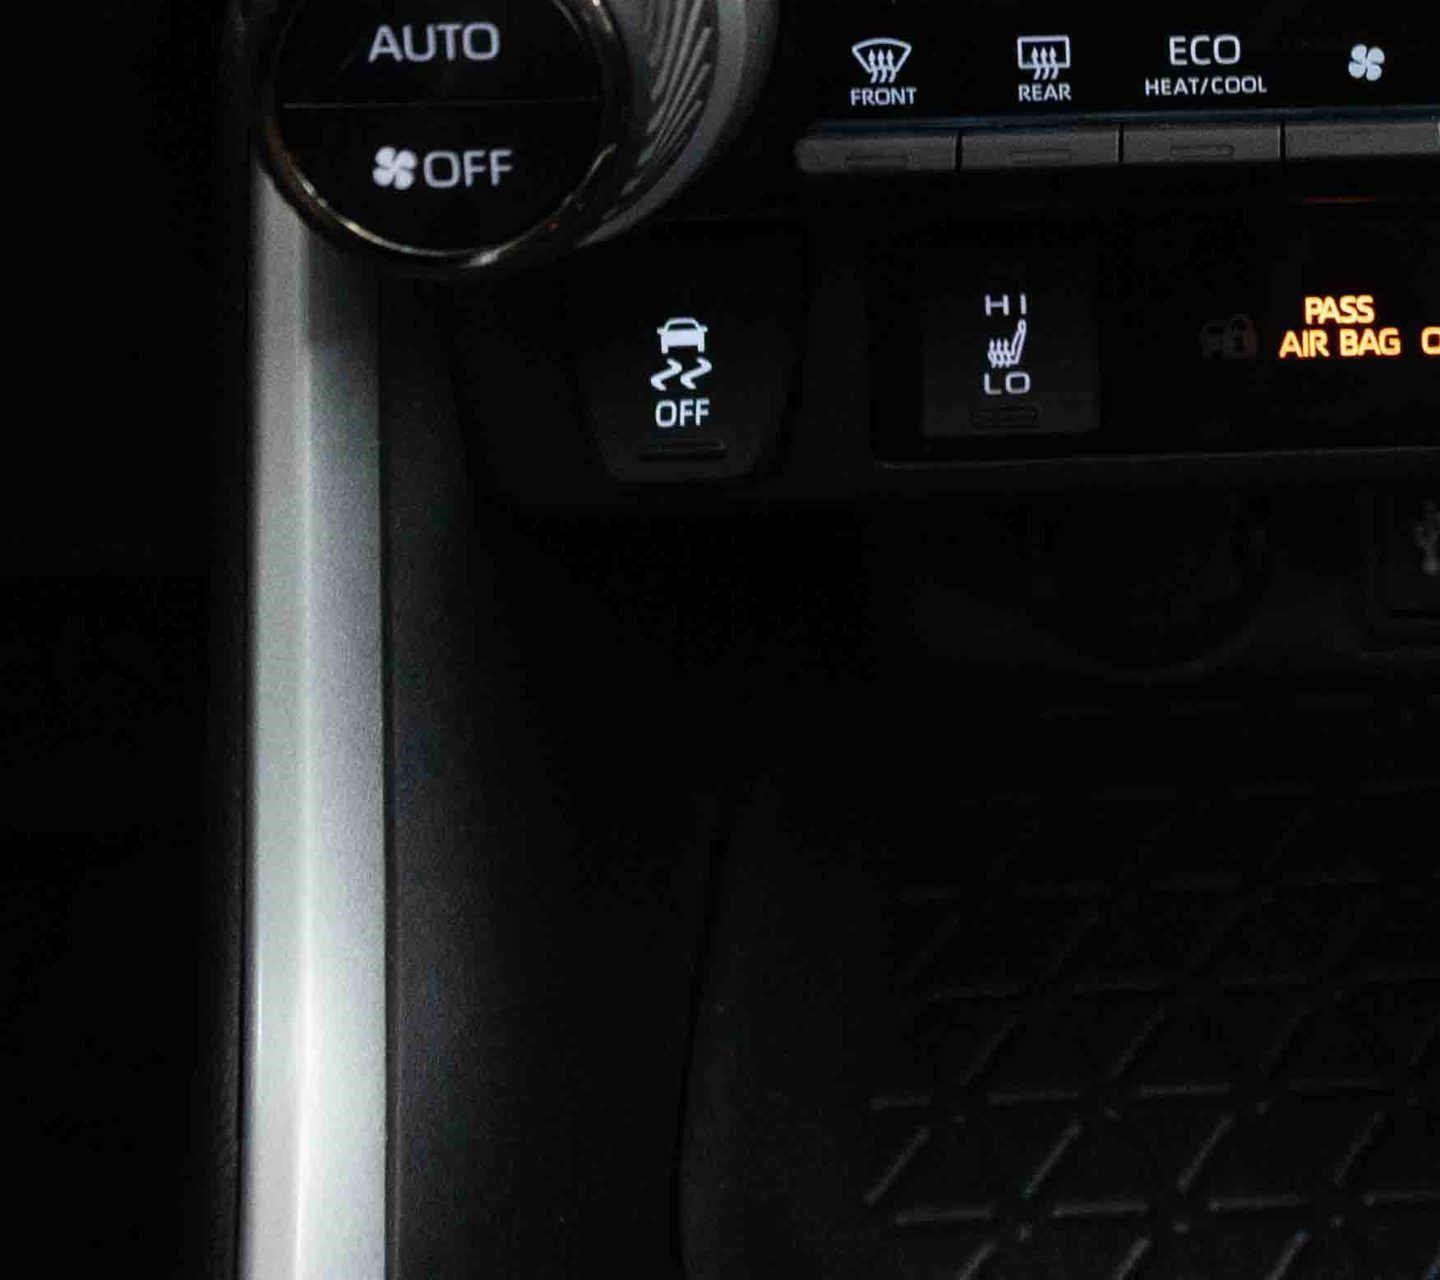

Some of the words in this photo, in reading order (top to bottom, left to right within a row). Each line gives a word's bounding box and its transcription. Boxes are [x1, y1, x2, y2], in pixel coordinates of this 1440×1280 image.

[368, 22, 500, 63] AUTO
[1169, 34, 1241, 66] ECO
[850, 87, 917, 106] FRONT
[1017, 83, 1072, 102] REAR
[1144, 75, 1267, 96] HEAT/COOL
[423, 149, 512, 189] OFF
[984, 293, 1027, 316] HI
[1304, 294, 1375, 325] PASS
[1278, 328, 1331, 359] AIR
[1339, 327, 1401, 357] BAG
[983, 371, 1031, 395] LO
[655, 398, 710, 428] OFF
